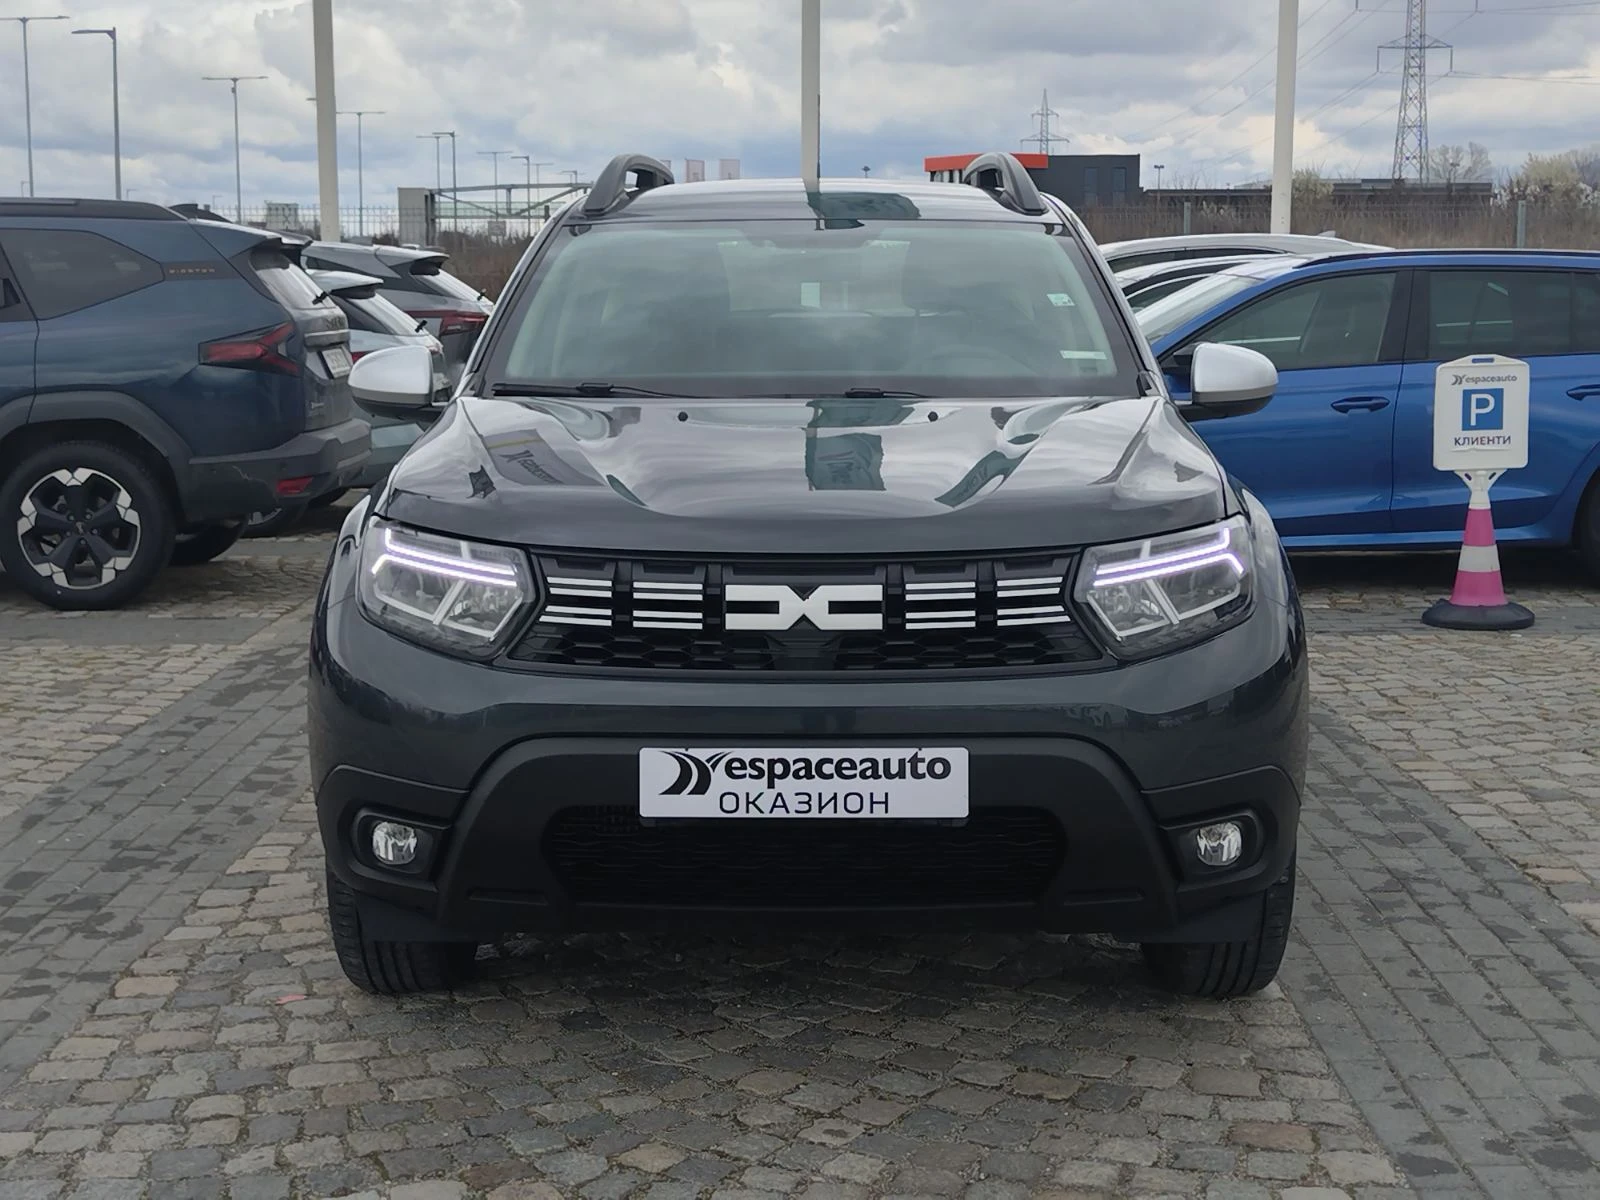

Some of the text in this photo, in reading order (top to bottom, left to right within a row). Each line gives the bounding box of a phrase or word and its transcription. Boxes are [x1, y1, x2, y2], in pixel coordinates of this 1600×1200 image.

[1465, 374, 1517, 384] espaceauto
[1470, 393, 1495, 426] P
[1454, 435, 1512, 446] КЛИЕНТИ
[724, 751, 952, 790] espaceauto
[719, 791, 890, 815] ОКАЗИОН
